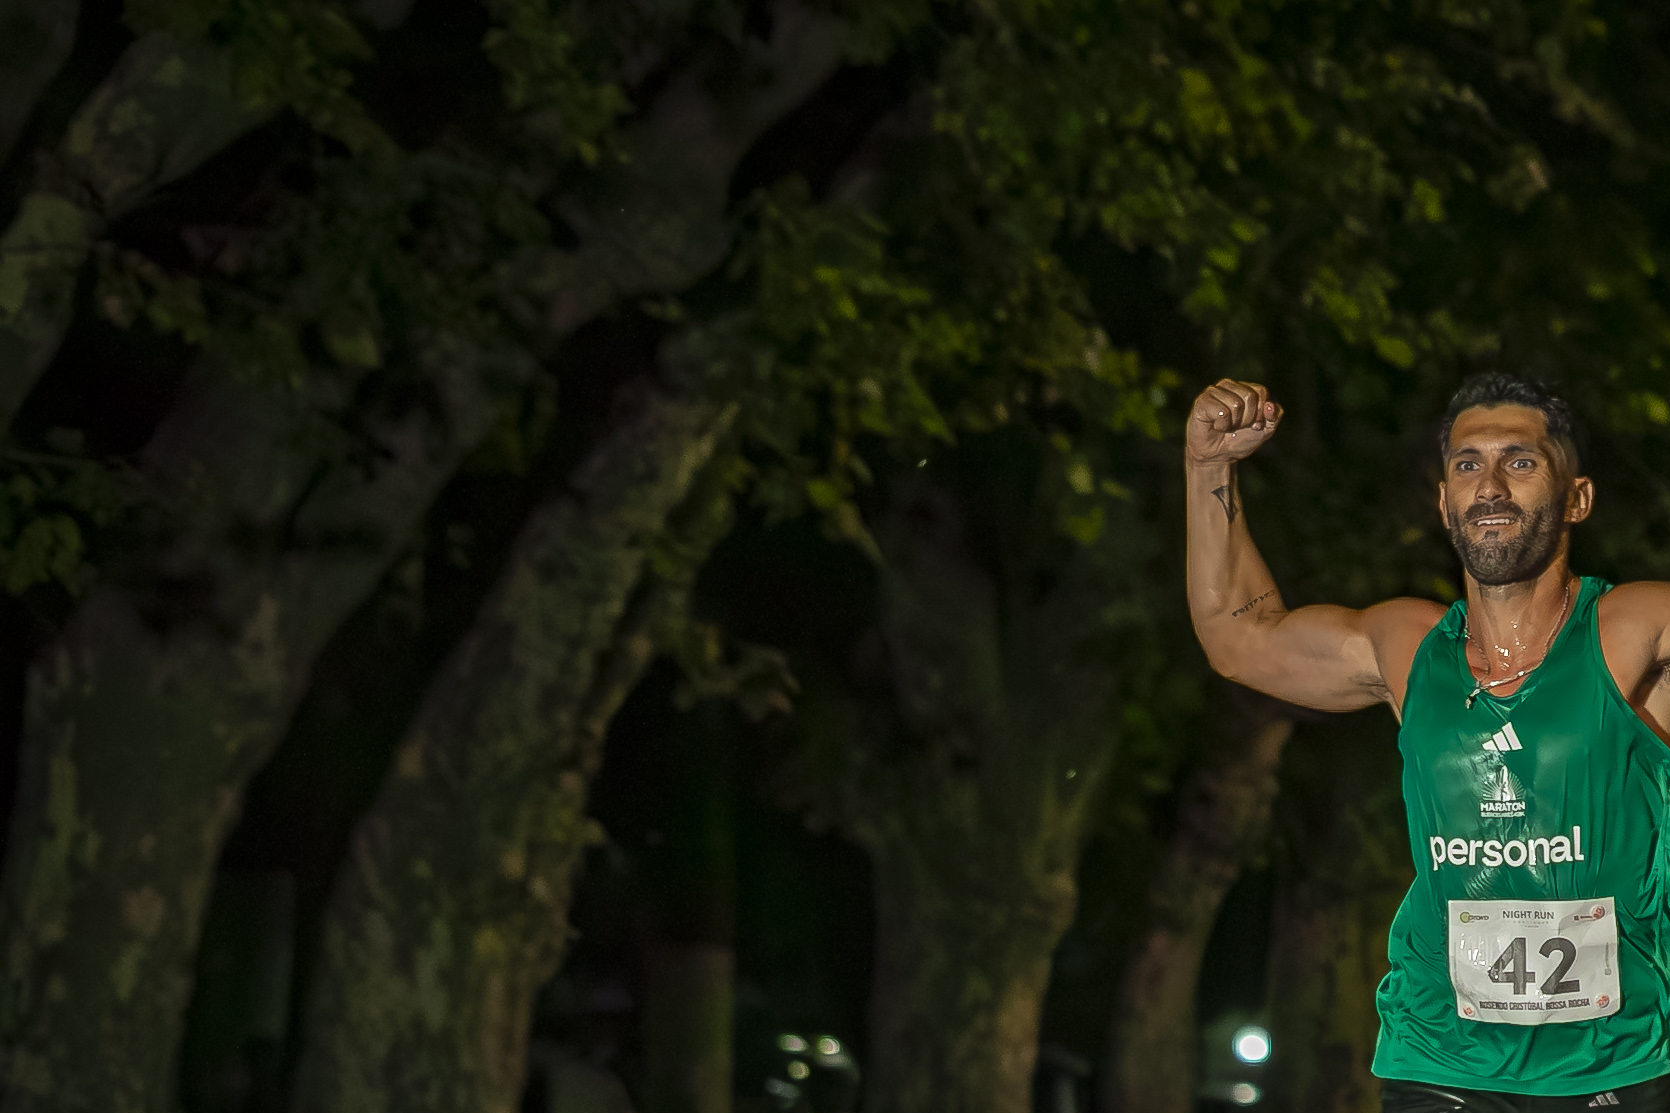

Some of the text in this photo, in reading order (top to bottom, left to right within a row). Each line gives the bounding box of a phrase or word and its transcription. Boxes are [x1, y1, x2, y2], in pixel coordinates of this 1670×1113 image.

[1479, 801, 1526, 812] MARATON
[1429, 825, 1585, 871] personal
[1502, 910, 1555, 920] NIGHT RUN
[1487, 936, 1581, 995] 42
